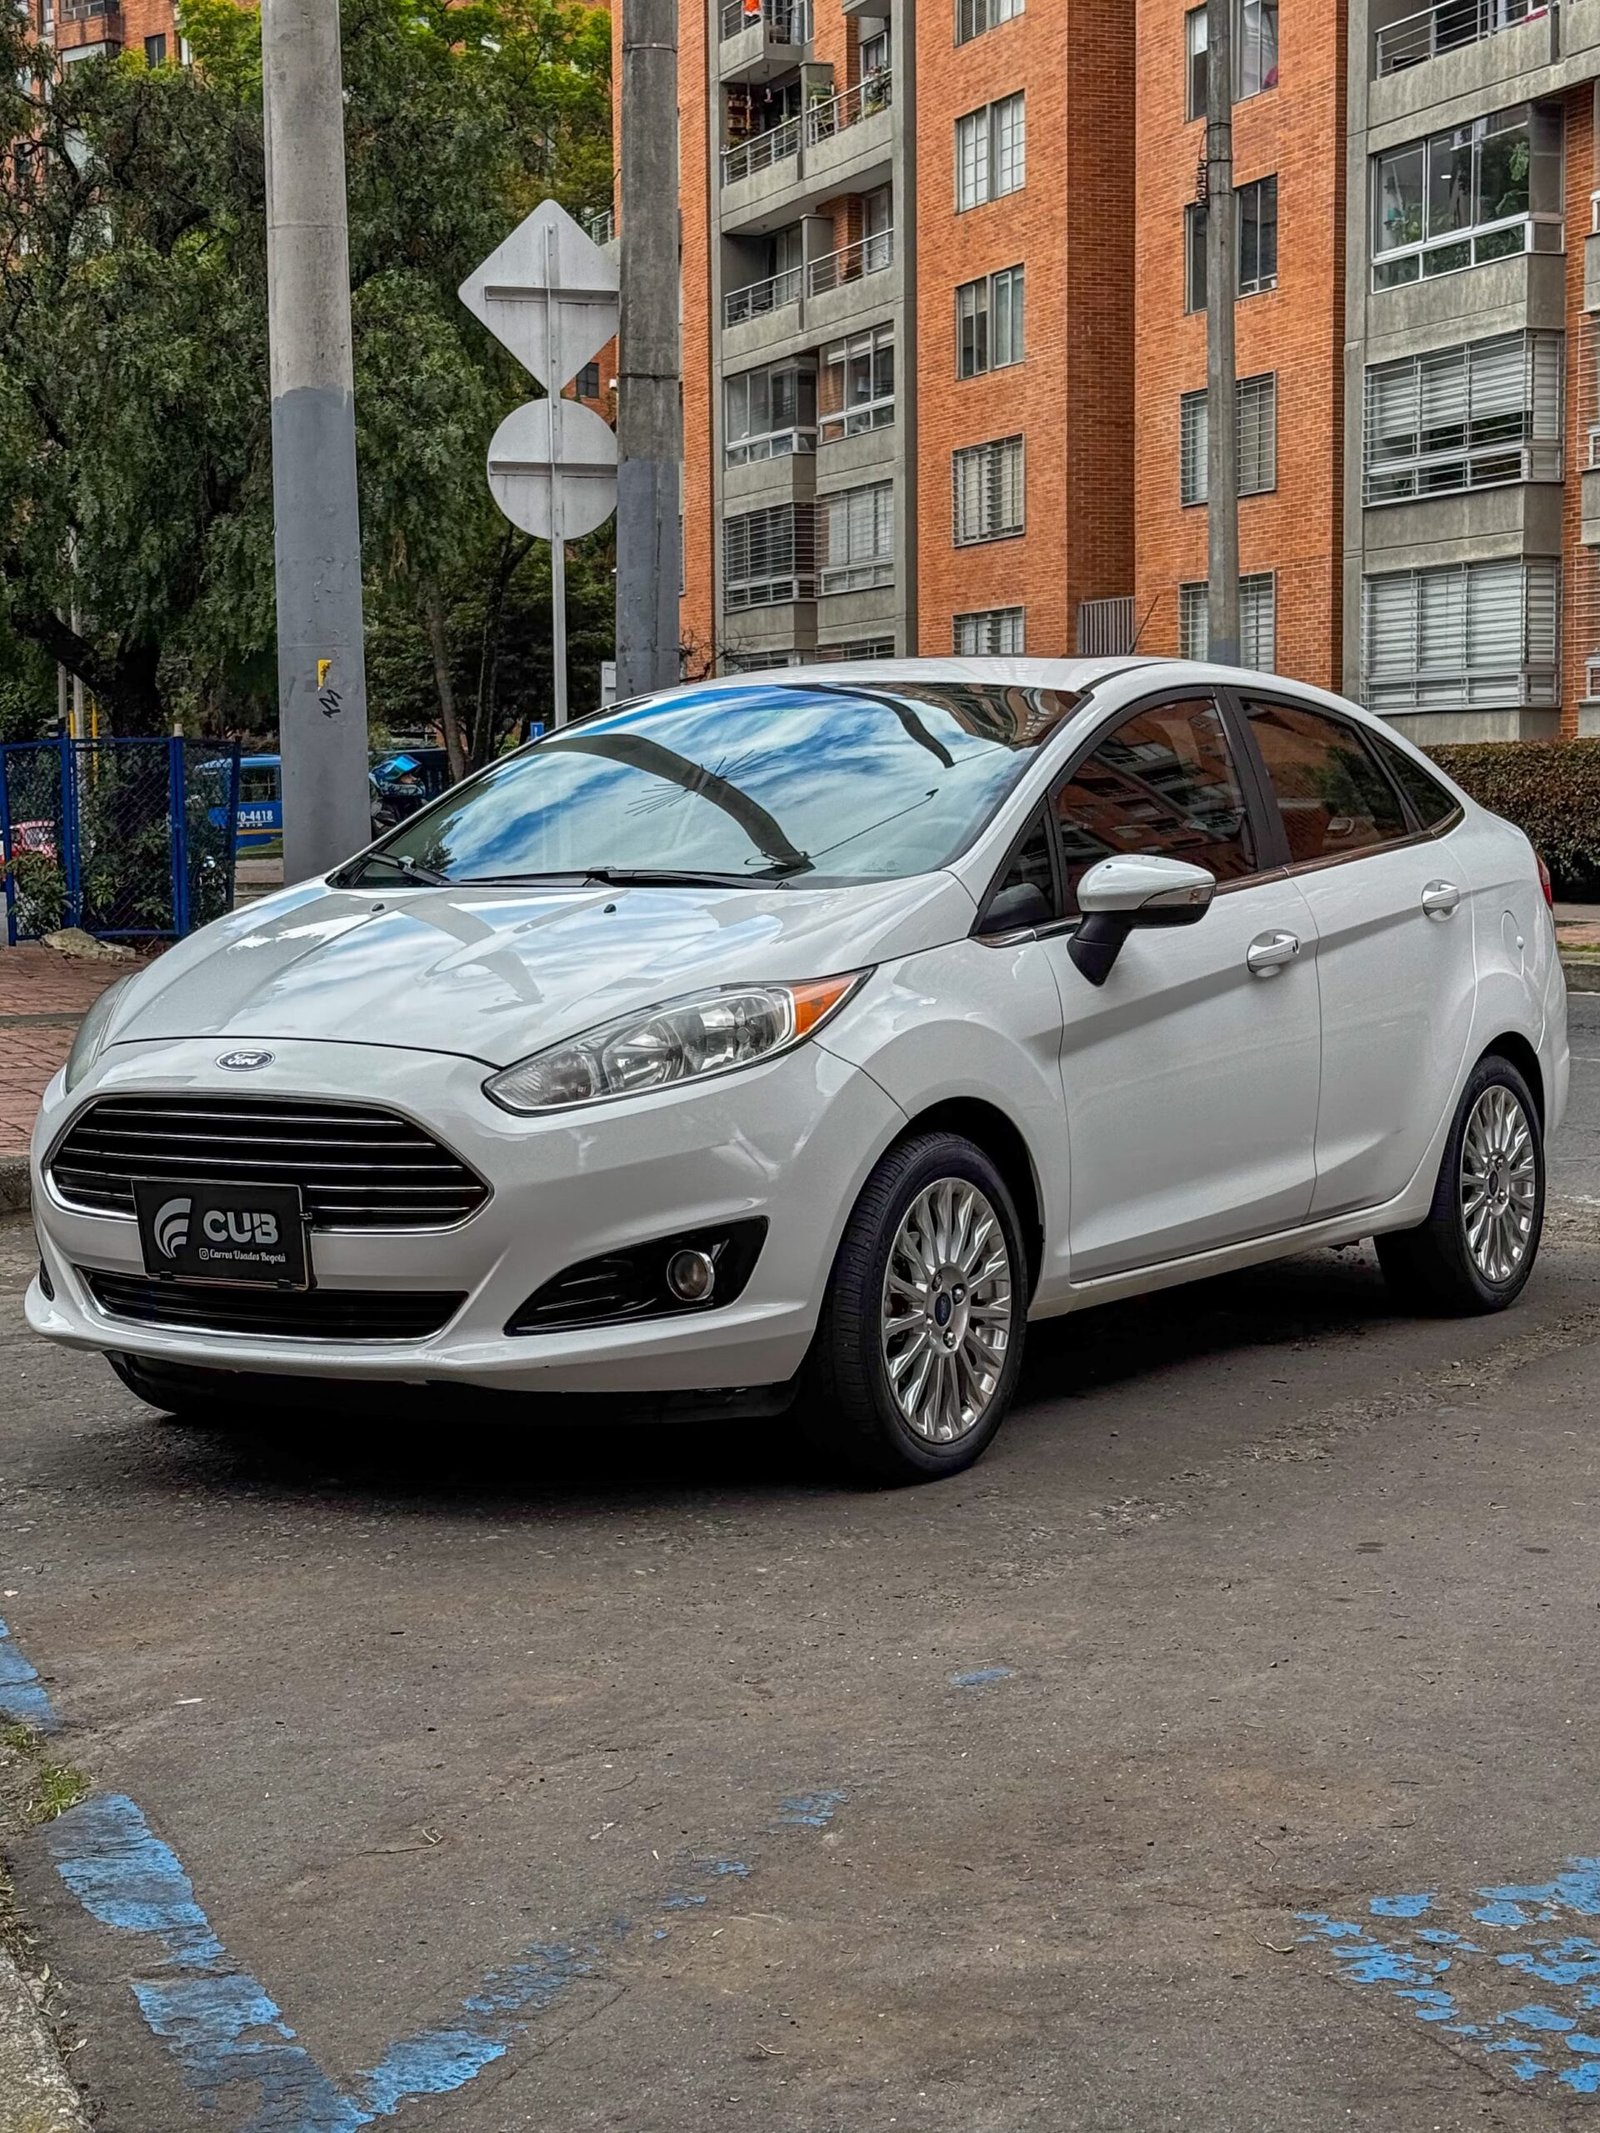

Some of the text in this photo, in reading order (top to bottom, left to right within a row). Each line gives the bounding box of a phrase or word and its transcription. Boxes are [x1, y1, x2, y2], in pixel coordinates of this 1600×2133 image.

[227, 1053, 262, 1065] Ford
[203, 1210, 278, 1244] CUB
[210, 1249, 233, 1259] Carros
[233, 1250, 259, 1261] Usados
